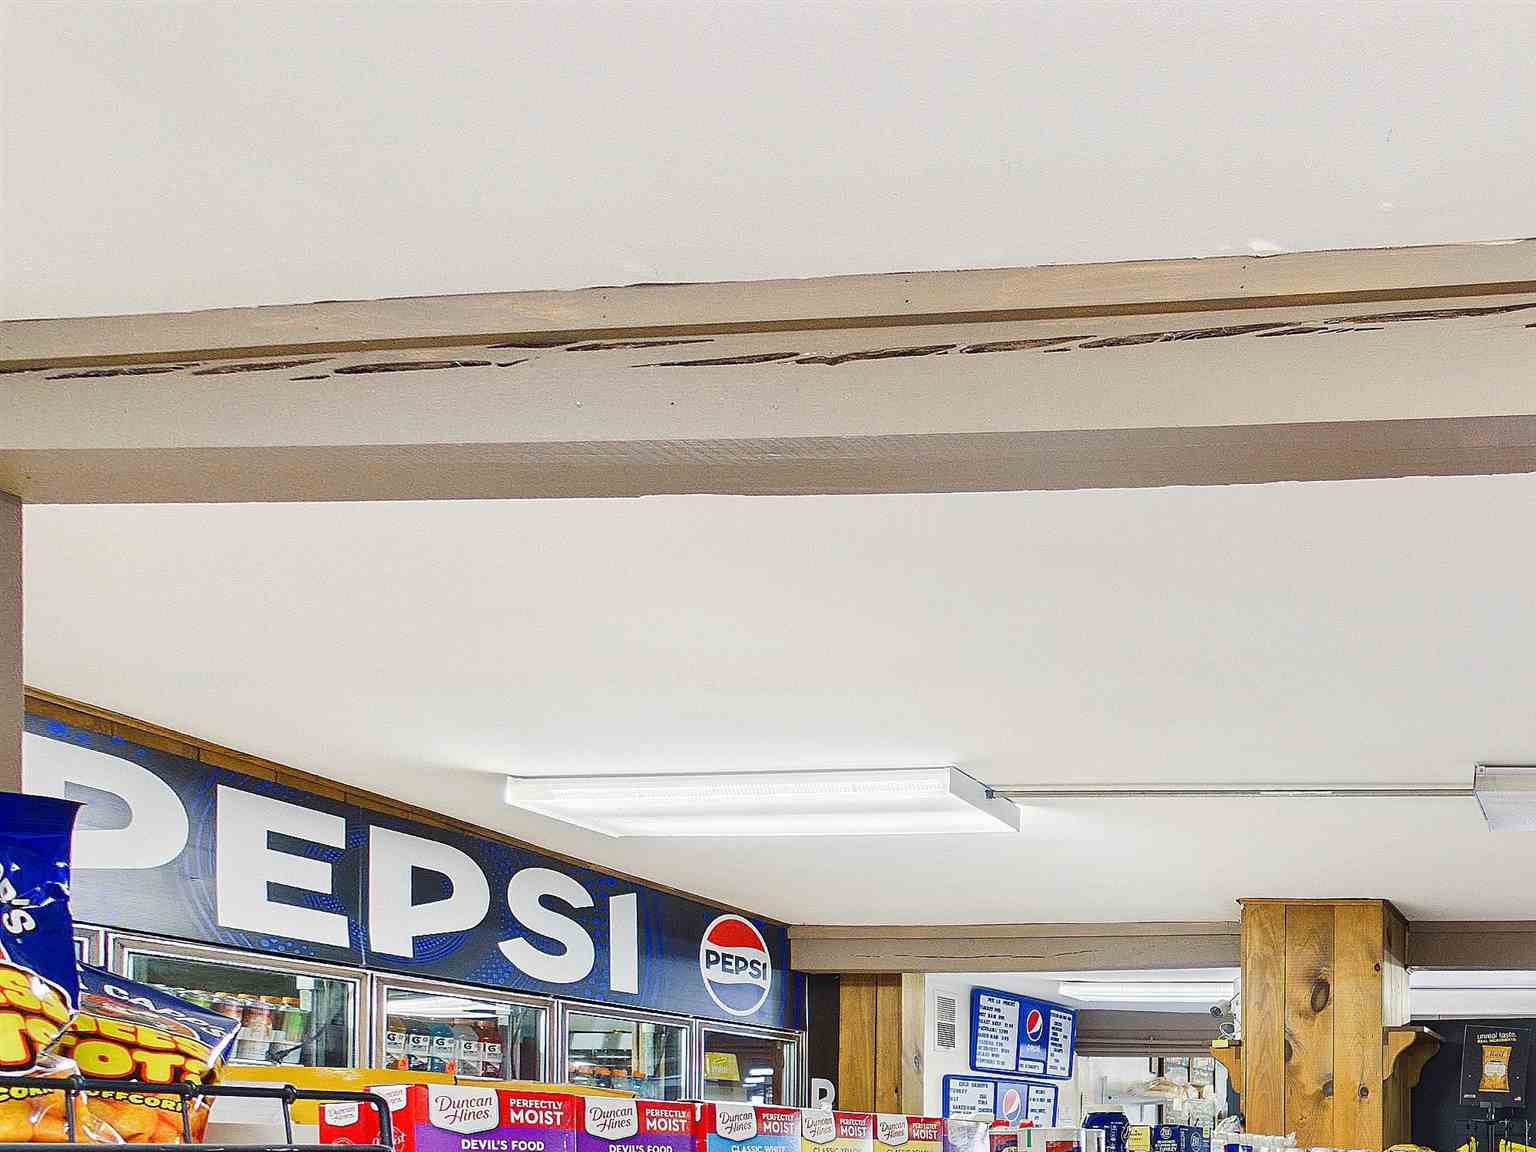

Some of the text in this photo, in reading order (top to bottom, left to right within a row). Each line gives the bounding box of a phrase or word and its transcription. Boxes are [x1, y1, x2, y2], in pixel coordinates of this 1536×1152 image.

[23, 733, 639, 993] PEPSI
[705, 949, 768, 984] PEPSI
[435, 1095, 493, 1112] Duncan
[510, 1098, 562, 1110] PERFECTLY
[444, 1108, 491, 1122] Hines
[510, 1110, 564, 1125] MOIST
[589, 1106, 633, 1122] Duncan
[646, 1108, 688, 1119] PERFECTLY
[719, 1111, 753, 1126] Duncan
[762, 1113, 794, 1122] PERFECTLY
[597, 1118, 632, 1131] Hines
[646, 1119, 688, 1132] MOIST
[724, 1120, 752, 1134] Hines
[762, 1122, 796, 1134] MOIST
[840, 1127, 868, 1137] MOIST
[912, 1129, 938, 1139] MOIST
[461, 1139, 545, 1151] DEVIL'S FOOD
